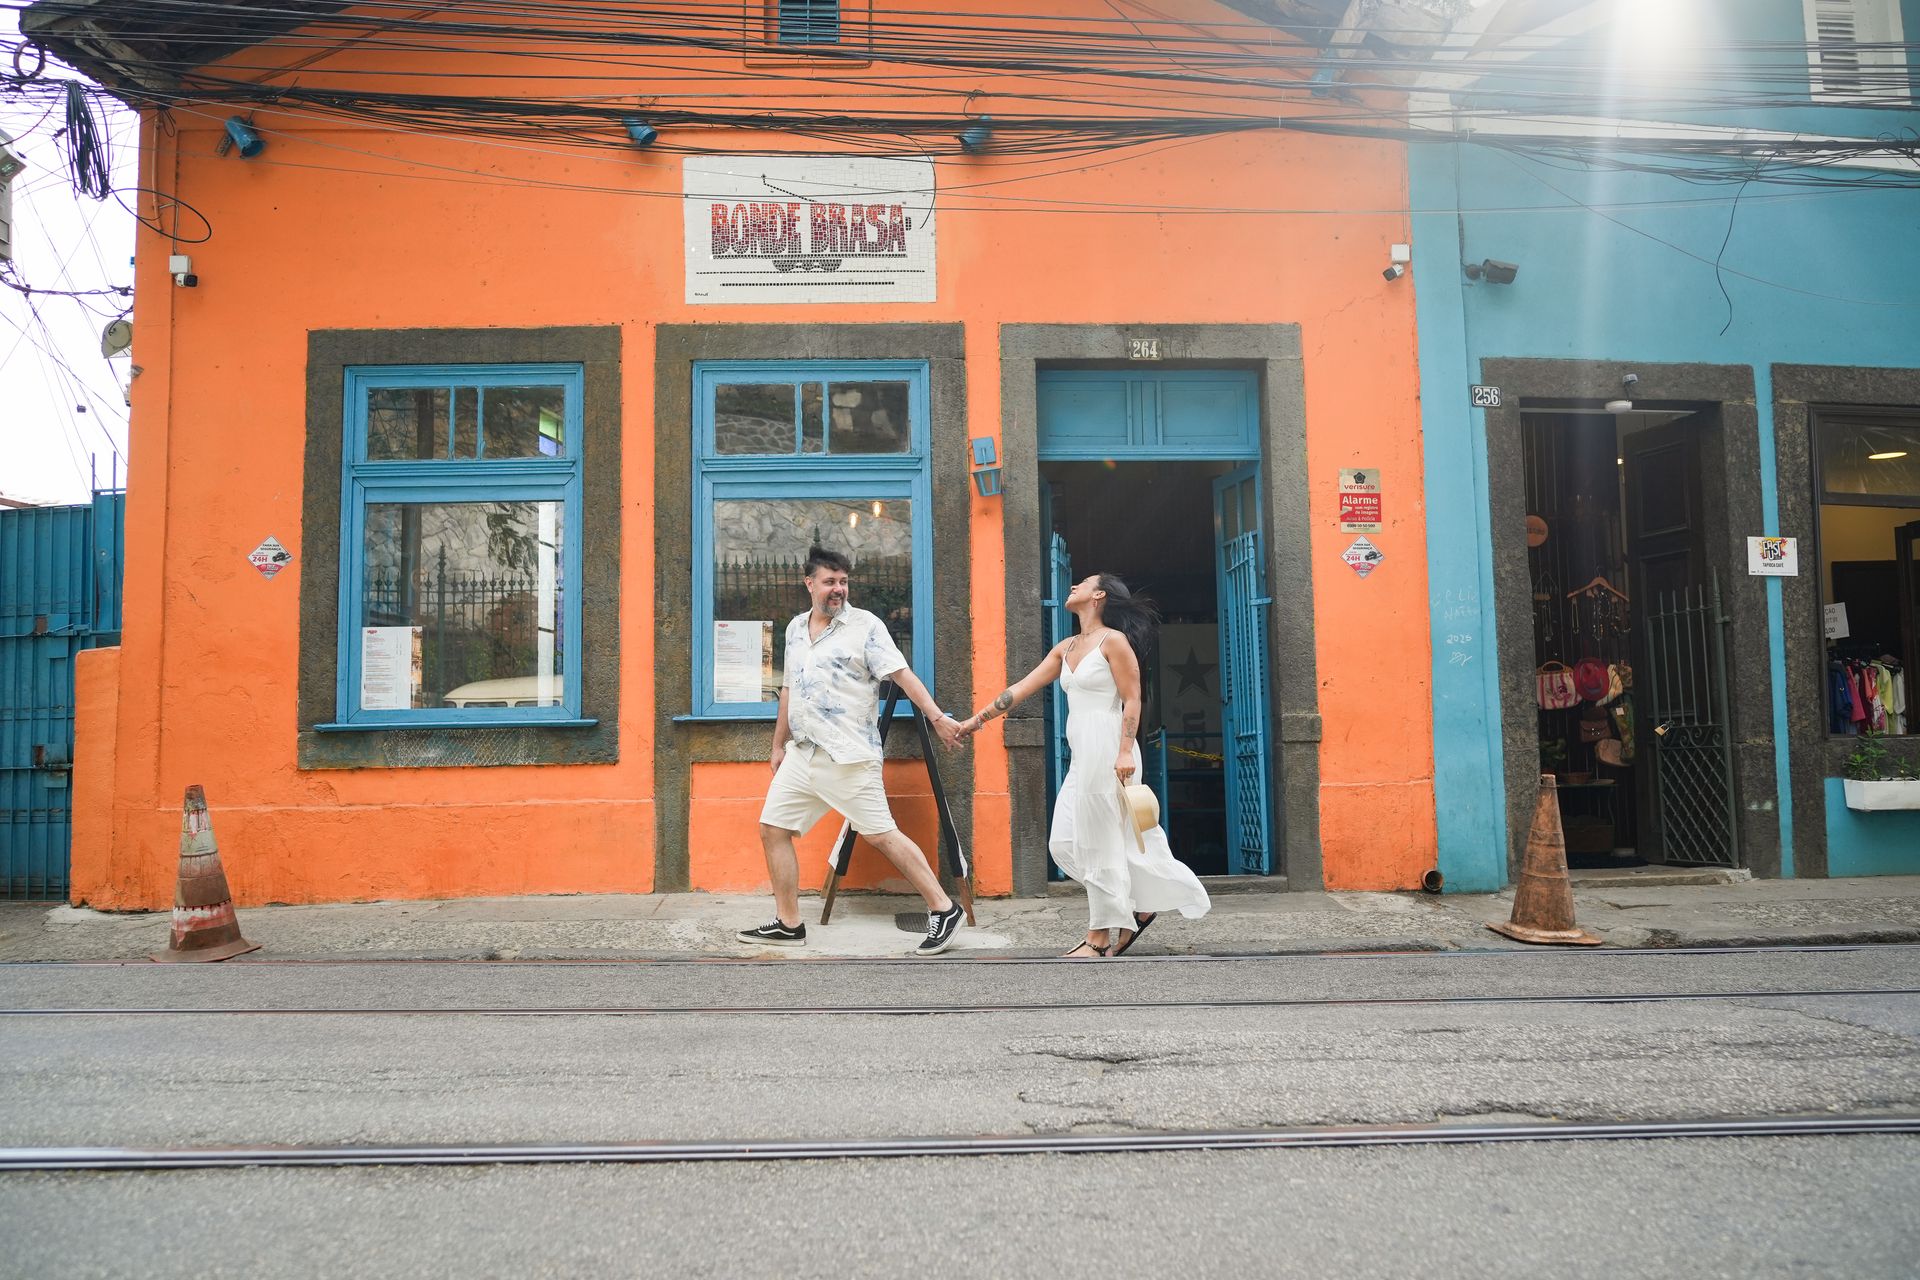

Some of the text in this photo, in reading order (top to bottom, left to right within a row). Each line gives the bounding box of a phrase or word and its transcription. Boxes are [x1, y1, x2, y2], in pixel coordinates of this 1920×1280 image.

[711, 202, 906, 254] BONDE BRASA
[1132, 340, 1158, 358] 264
[1474, 387, 1499, 405] 256
[1342, 495, 1378, 505] Alarme
